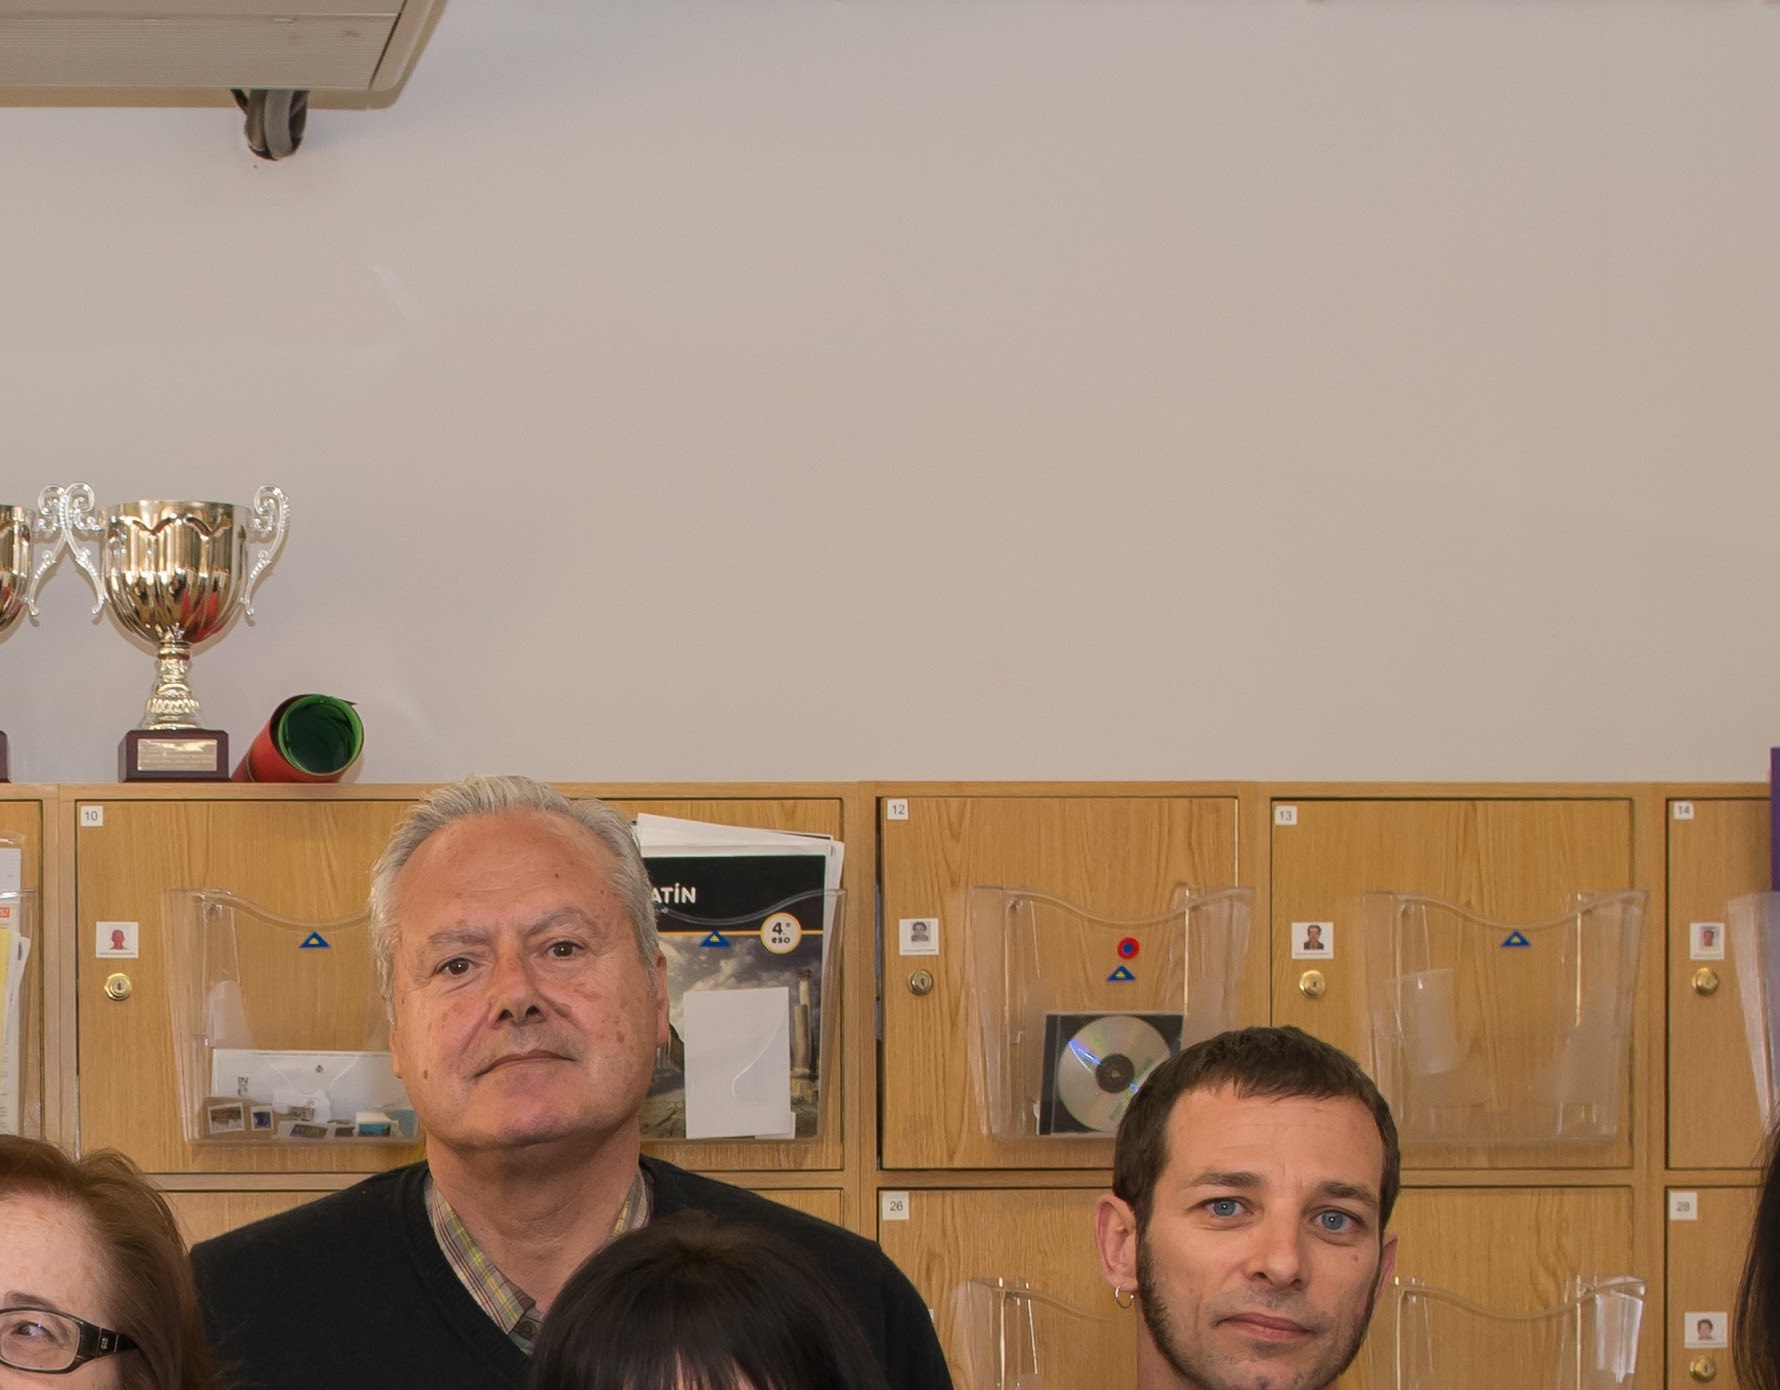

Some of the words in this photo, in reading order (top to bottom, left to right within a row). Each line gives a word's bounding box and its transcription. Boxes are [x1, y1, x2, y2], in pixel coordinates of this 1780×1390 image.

[893, 805, 905, 816] 12
[1678, 804, 1690, 815] 14
[85, 810, 98, 821] 10
[1280, 811, 1293, 821] 13
[651, 882, 697, 904] ATÍN
[771, 936, 791, 944] eso
[890, 1201, 903, 1212] 26
